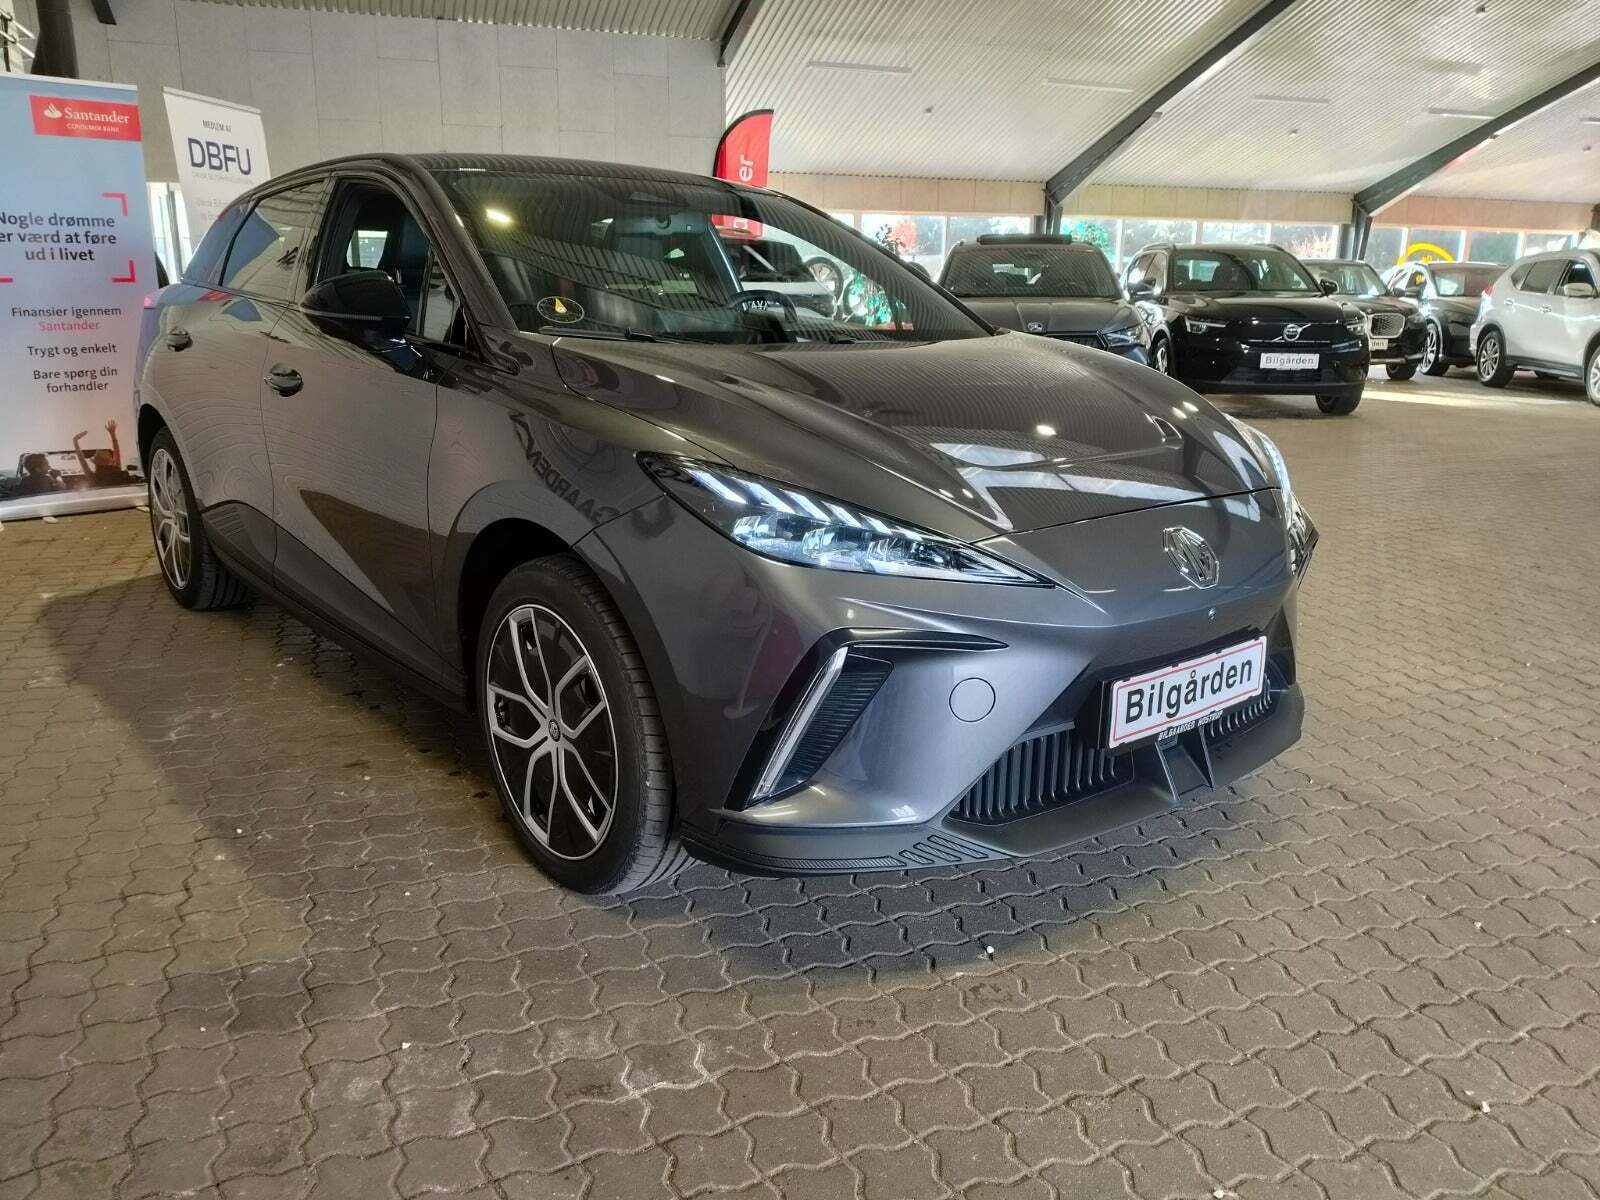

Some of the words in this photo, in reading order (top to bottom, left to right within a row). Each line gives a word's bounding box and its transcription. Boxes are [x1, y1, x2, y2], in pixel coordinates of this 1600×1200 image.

[64, 106, 130, 124] Santander
[187, 137, 252, 175] DBFU
[48, 212, 115, 228] drømme
[17, 230, 60, 243] værd
[64, 232, 81, 244] at
[84, 231, 117, 245] føre
[25, 247, 46, 260] ud
[50, 248, 55, 260] i
[59, 247, 95, 260] livet
[11, 306, 68, 317] Finansier
[71, 306, 122, 319] igennem
[39, 320, 100, 331] Santander
[27, 345, 60, 358] Trygt
[62, 346, 79, 357] og
[80, 343, 118, 355] enkelt
[33, 369, 61, 380] Bare
[63, 368, 98, 380] spørg
[99, 366, 118, 377] din
[46, 381, 109, 393] forhandler
[1125, 658, 1253, 725] Bilgården
